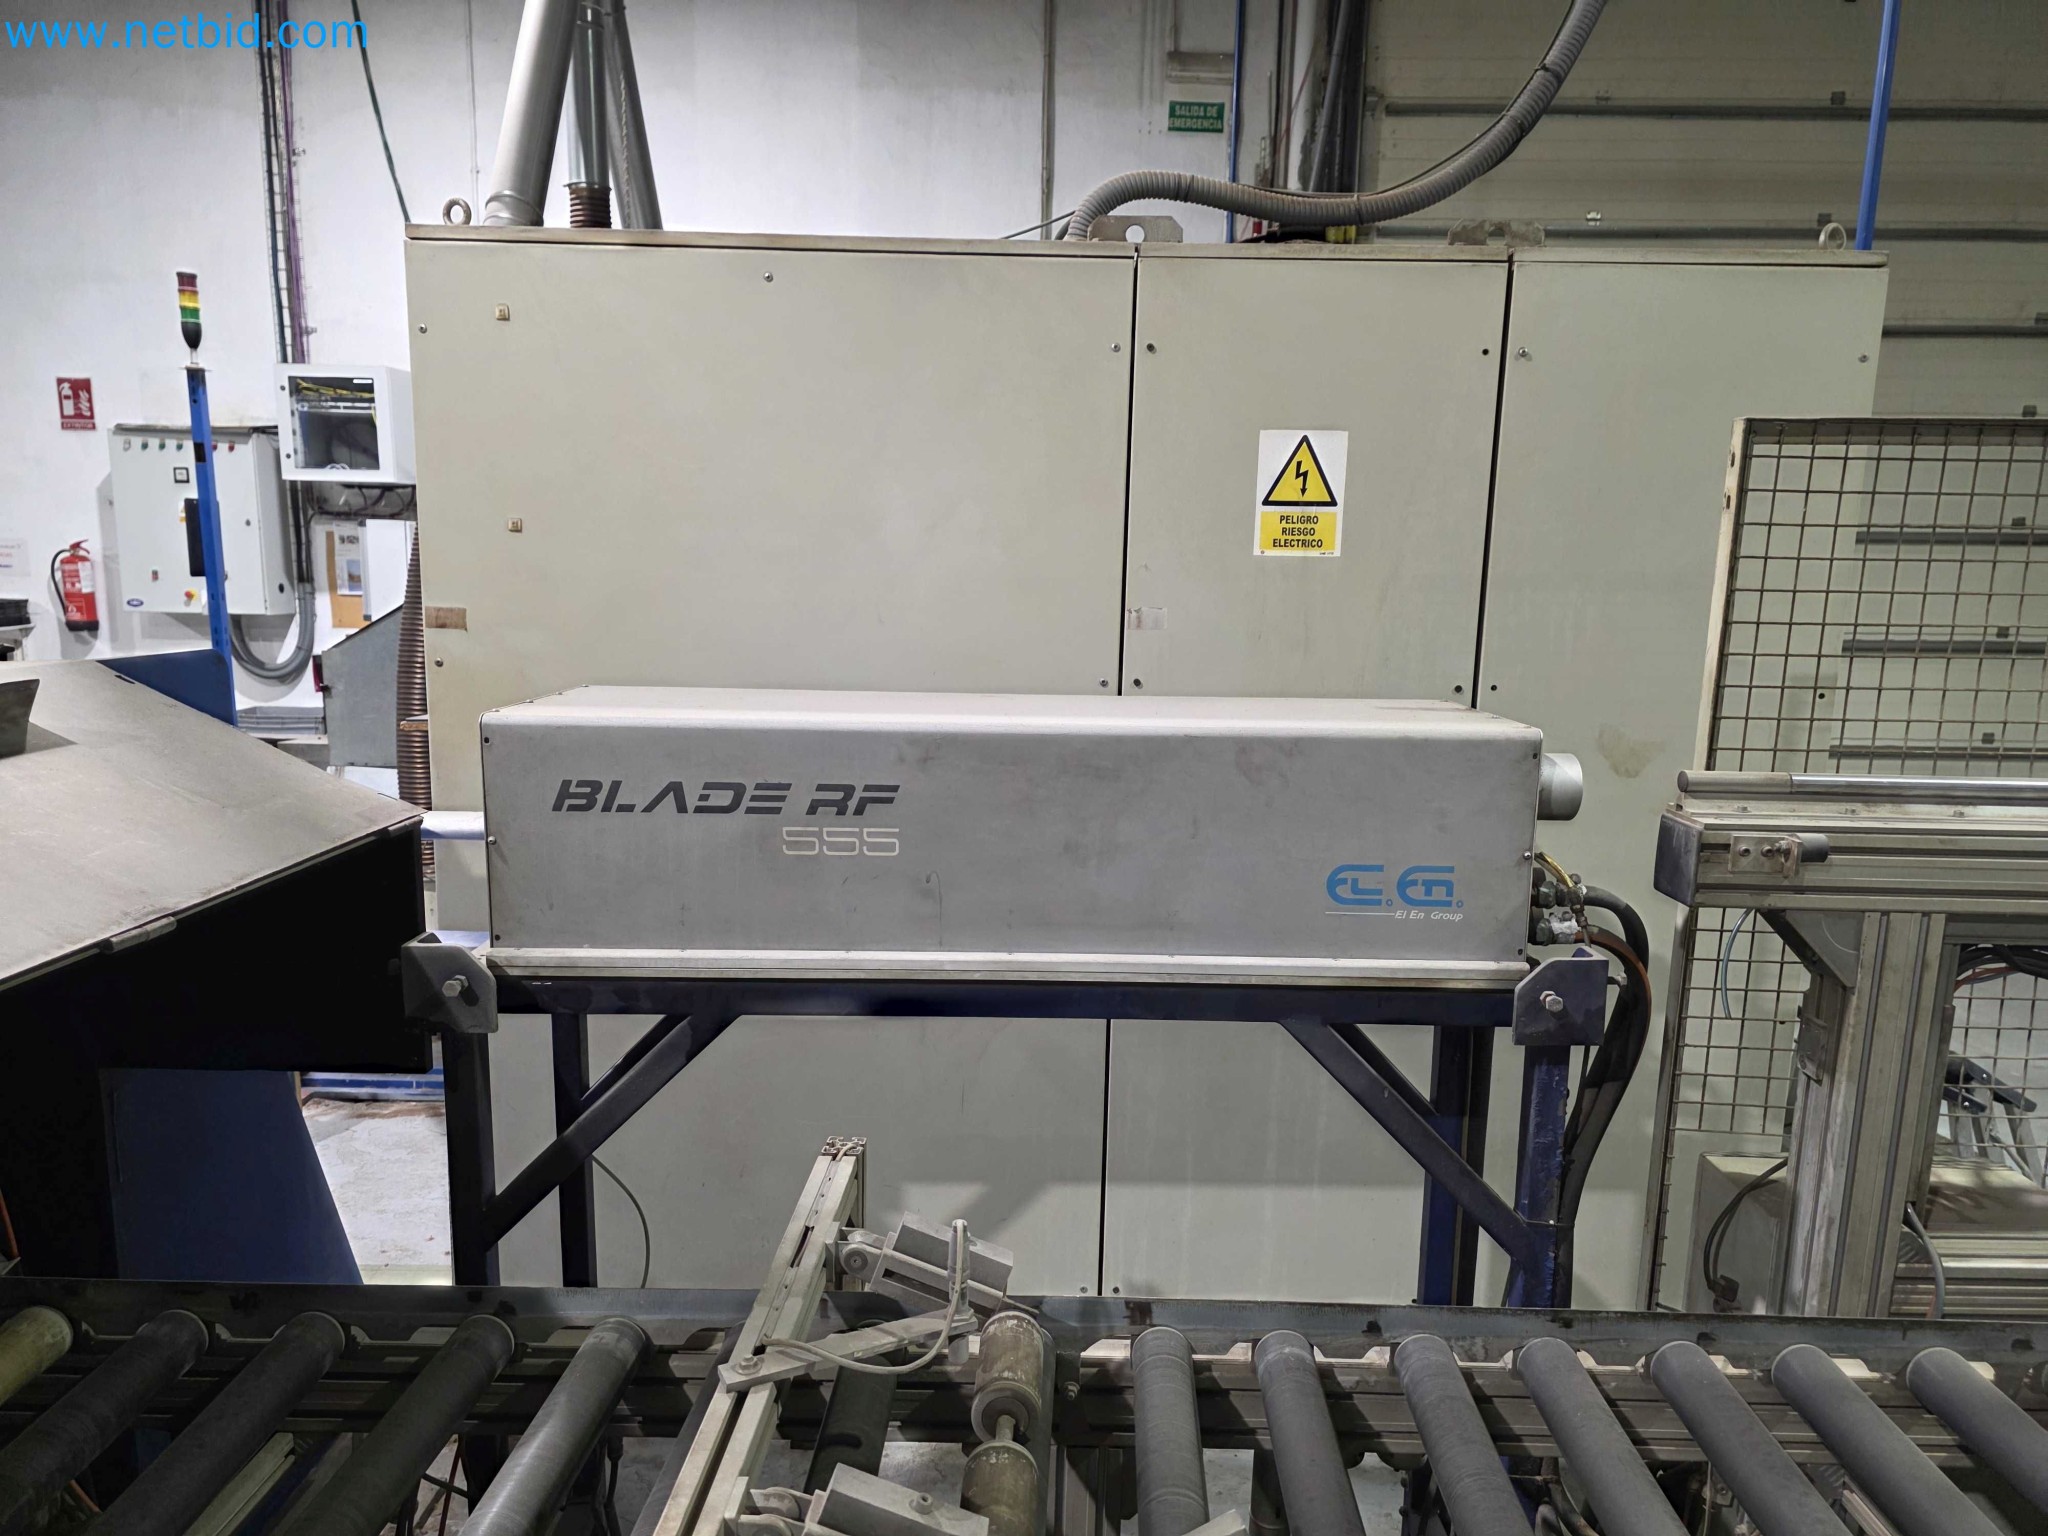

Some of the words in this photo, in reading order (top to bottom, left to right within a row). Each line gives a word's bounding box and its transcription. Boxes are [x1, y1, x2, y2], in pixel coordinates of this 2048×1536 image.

[1175, 105, 1205, 117] SALIDA
[1206, 106, 1218, 117] DE
[1169, 118, 1222, 129] EMERGENCIA
[1279, 515, 1319, 524] PELIGRO
[1281, 527, 1316, 536] RIESGO
[1272, 538, 1323, 548] ELECTRICO
[551, 779, 793, 815] BLADE
[805, 783, 901, 816] RF
[1409, 910, 1425, 919] En
[1430, 911, 1464, 922] Group
